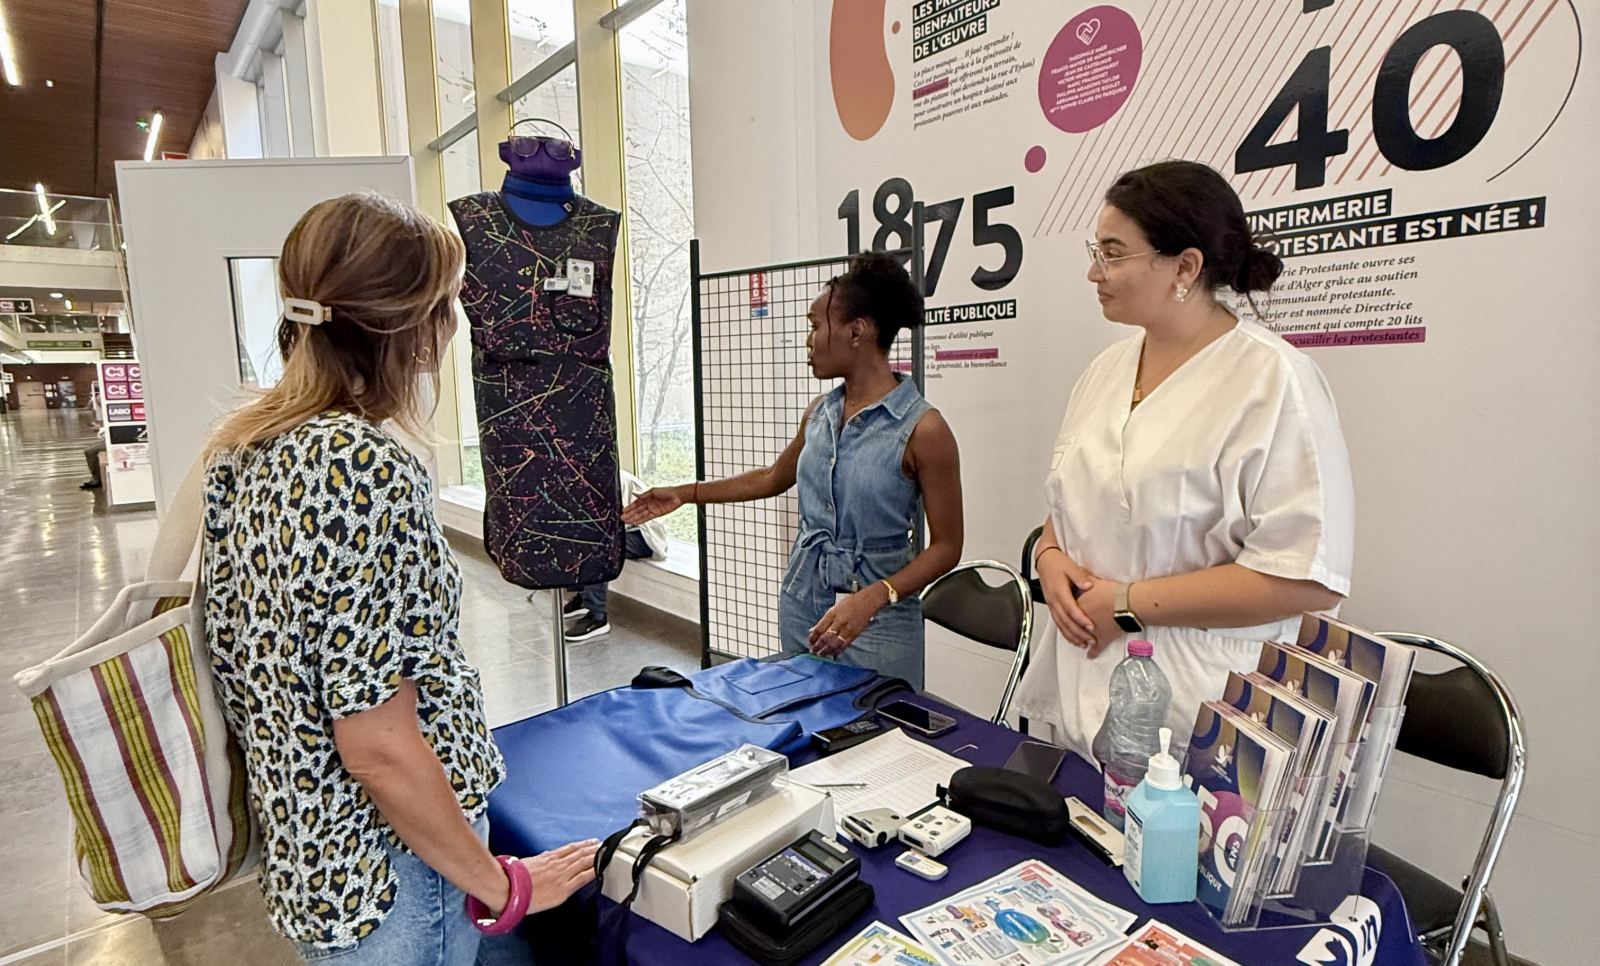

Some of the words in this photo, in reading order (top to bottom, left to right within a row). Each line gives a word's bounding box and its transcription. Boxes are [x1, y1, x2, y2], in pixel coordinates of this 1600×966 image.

[914, 1, 933, 20] LES
[914, 0, 998, 40] BIENFAITEURS
[914, 42, 929, 60] DE
[1235, 9, 1505, 190] 40
[1246, 194, 1388, 233] 'INFIRMERIE
[1252, 224, 1398, 257] OTESTANTE
[1405, 216, 1453, 241] EST
[1460, 204, 1520, 234] NÉE
[1528, 204, 1538, 225] !
[1299, 261, 1360, 276] Protestante
[1362, 258, 1395, 268] ouvre
[1397, 256, 1415, 265] ses
[1324, 275, 1355, 290] grâce
[1357, 275, 1372, 284] au
[1375, 270, 1418, 282] soutien
[1261, 292, 1328, 306] communauté
[1329, 288, 1396, 303] protestante.
[953, 302, 1015, 321] PUBLIQUE
[1290, 309, 1304, 318] est
[1306, 304, 1352, 317] nommée
[1354, 301, 1413, 314] Directrice
[1323, 319, 1341, 332] qui
[1343, 318, 1384, 330] compte
[1387, 316, 1402, 326] 20
[1404, 315, 1423, 325] lits
[1334, 334, 1348, 344] les
[1350, 331, 1420, 345] protestantes
[105, 367, 125, 377] C3
[129, 367, 140, 377] C
[107, 385, 127, 395] C5
[131, 383, 142, 393] C
[1227, 840, 1241, 868] ANS
[1198, 863, 1223, 893] BLIQUE
